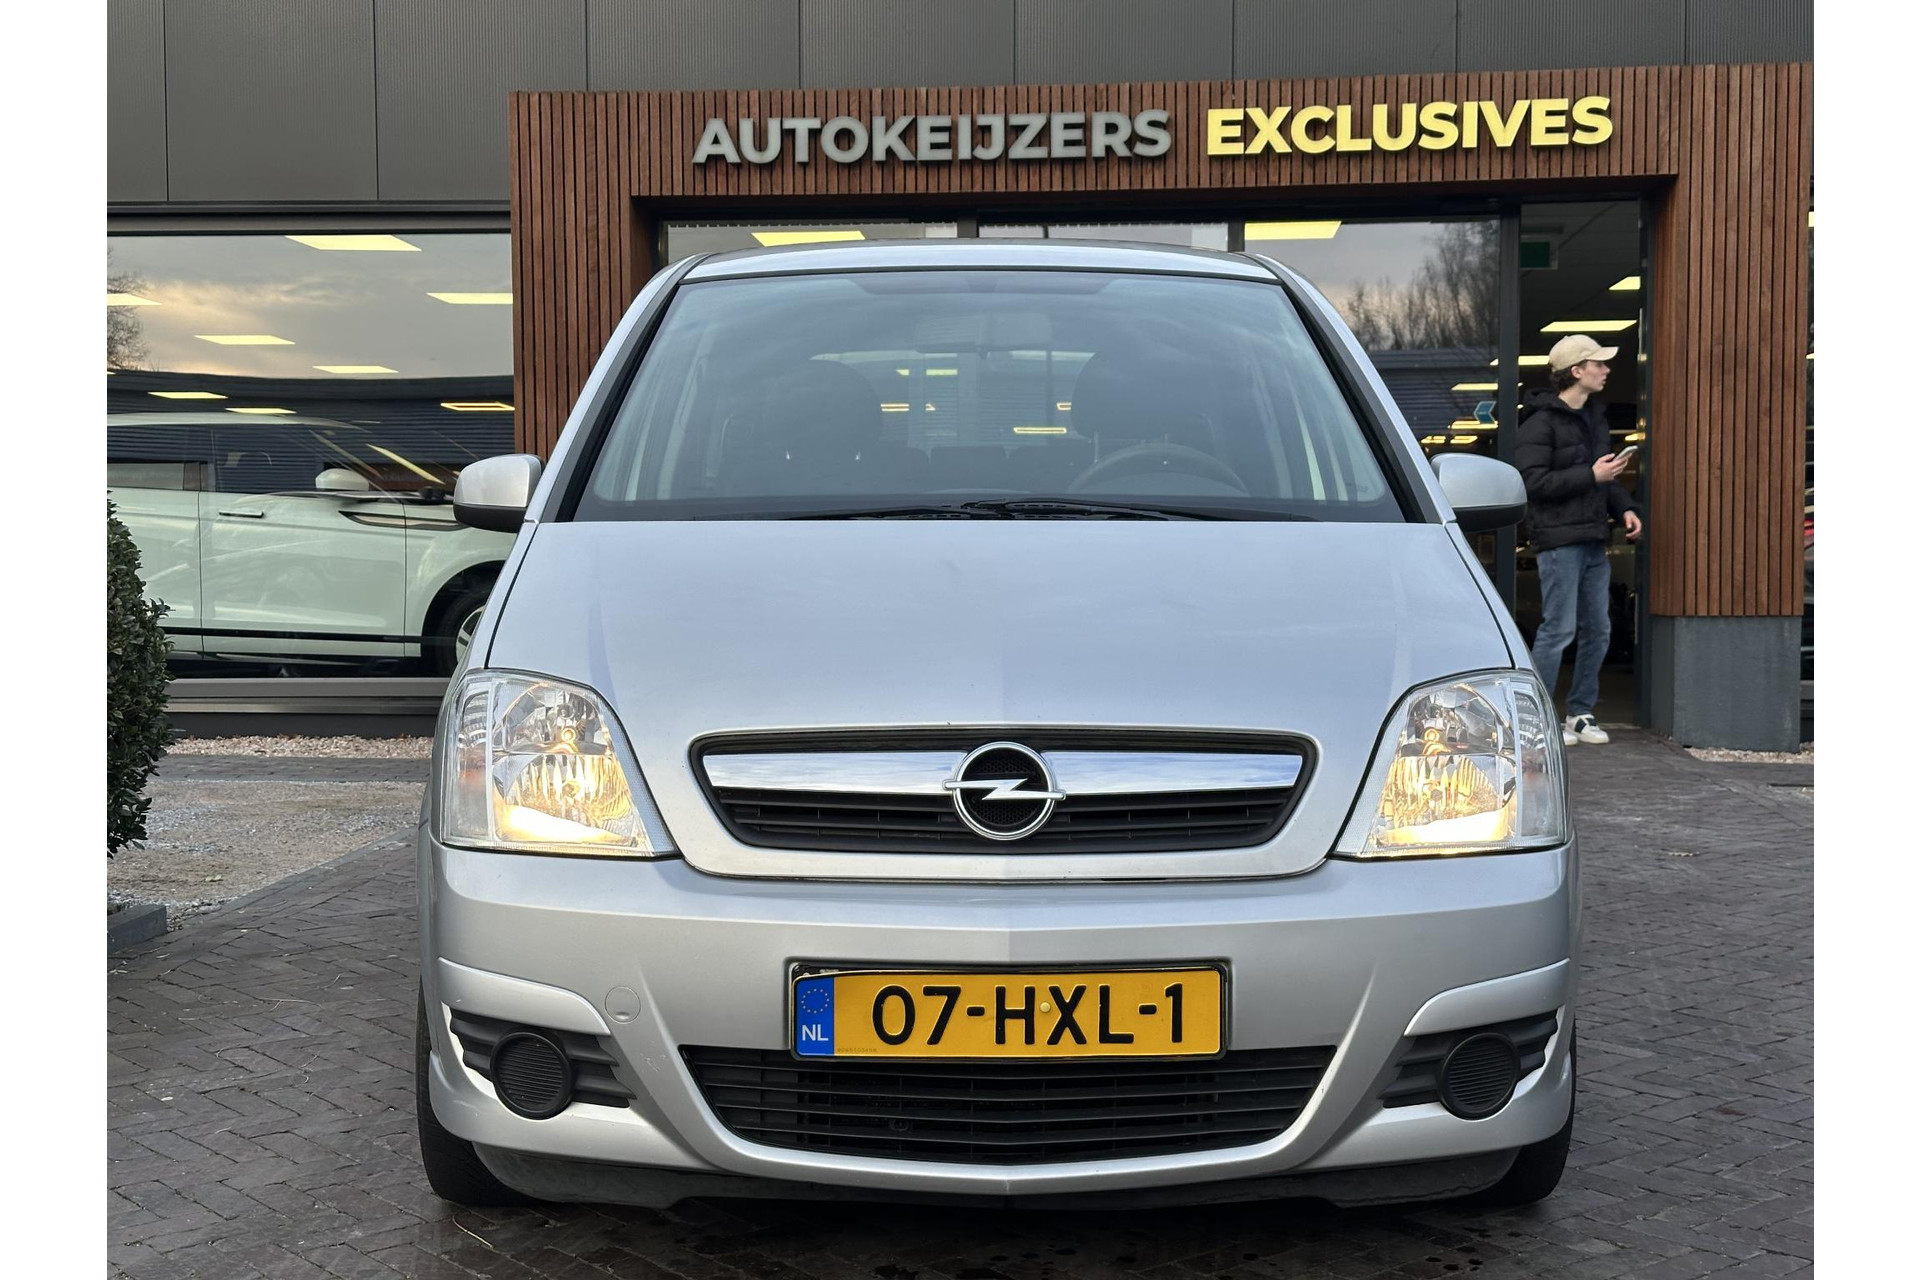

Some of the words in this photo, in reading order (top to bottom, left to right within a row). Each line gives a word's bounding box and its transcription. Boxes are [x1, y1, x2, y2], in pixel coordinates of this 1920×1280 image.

[692, 109, 1173, 163] AUTOKEIJZERS
[1207, 95, 1613, 155] EXCLUSIVES
[802, 1024, 829, 1041] NL
[872, 982, 1184, 1046] 07-HXL-1
